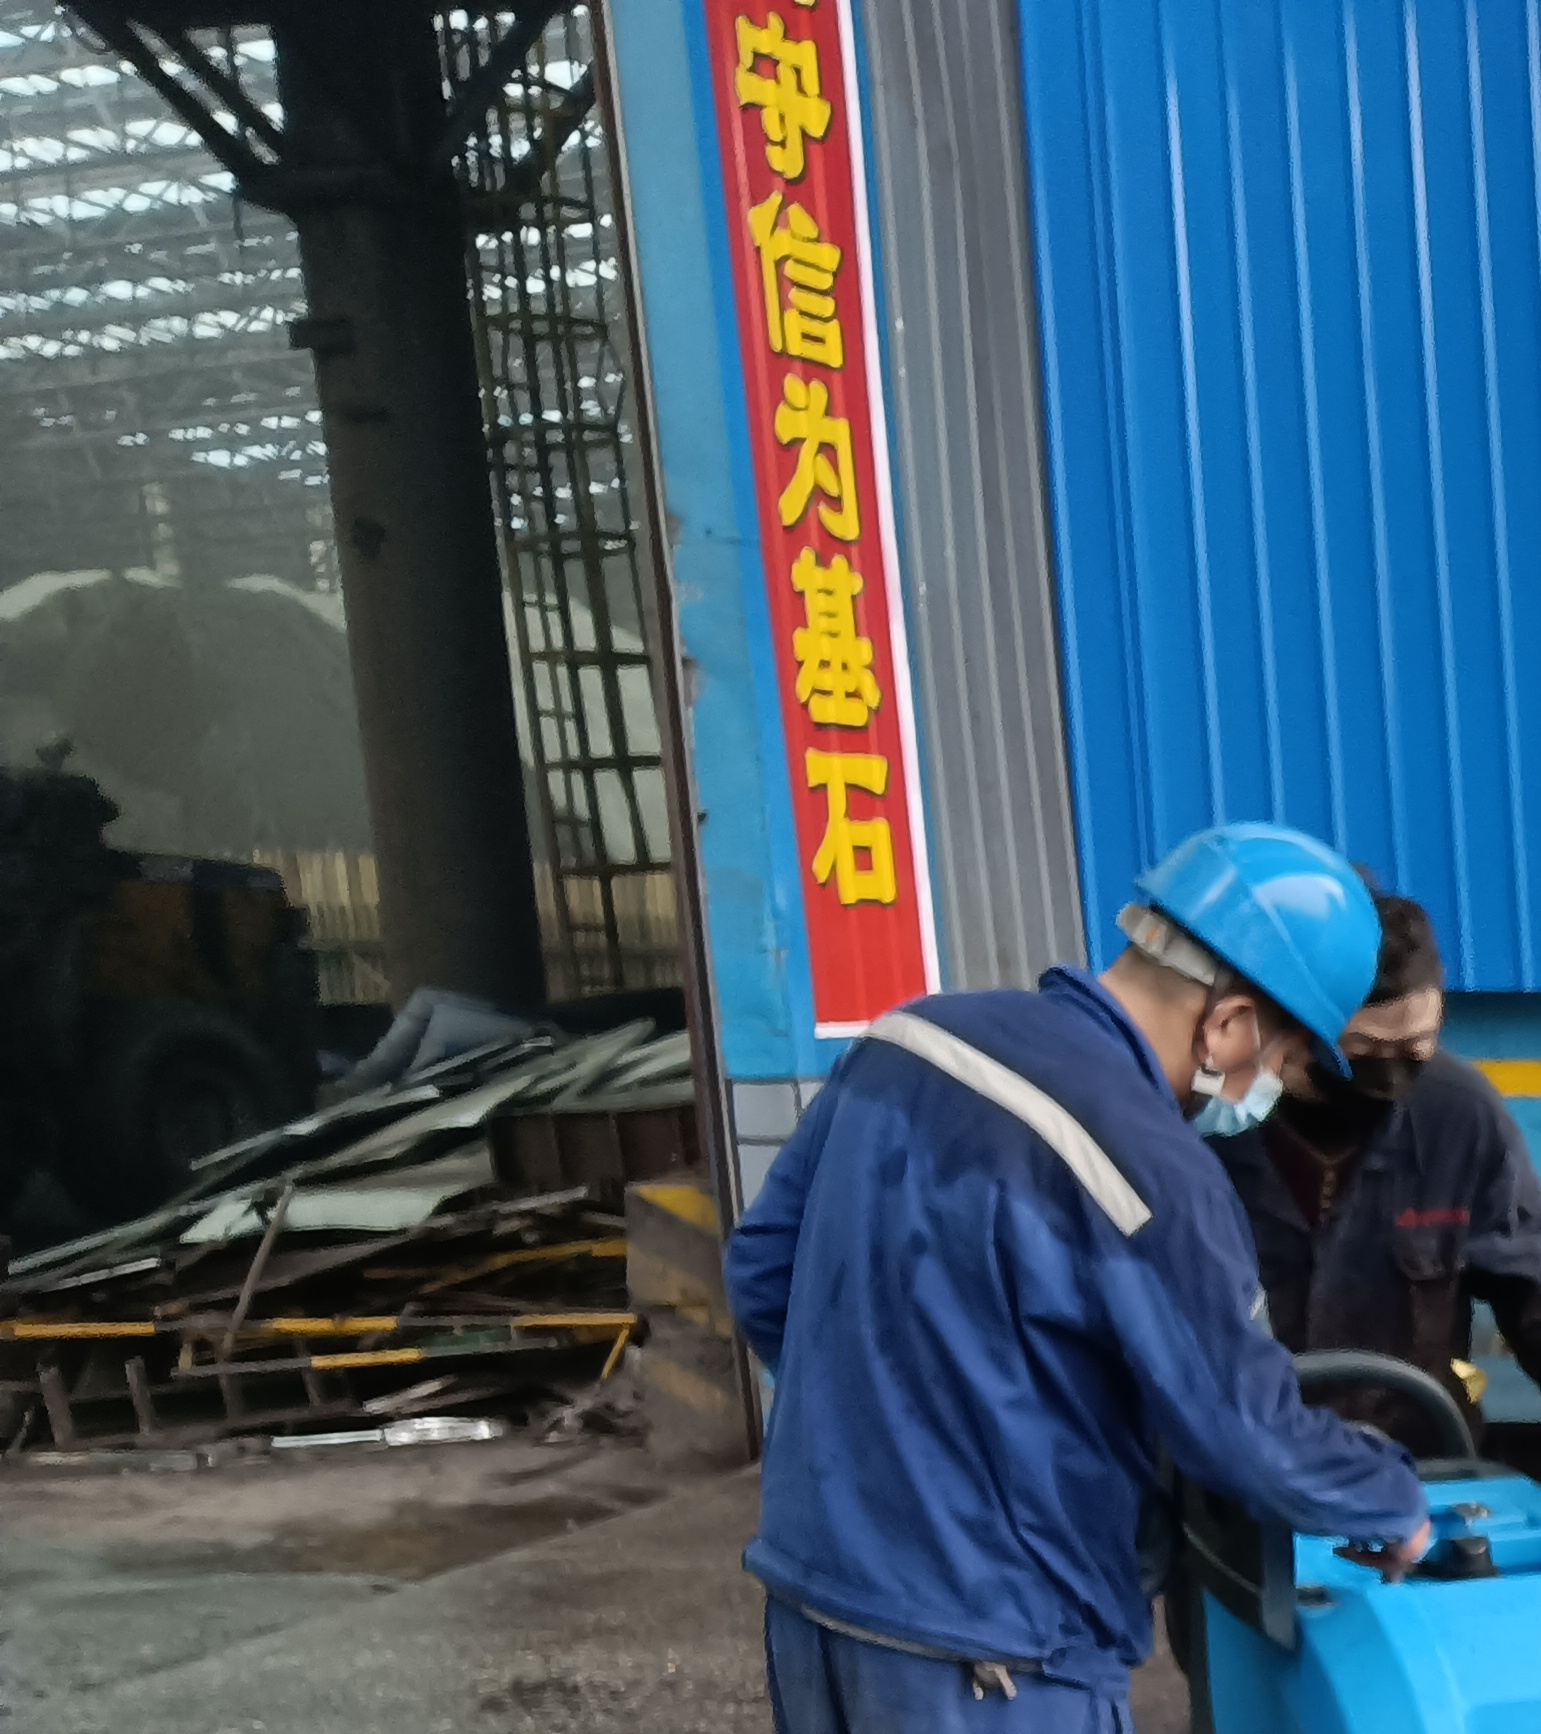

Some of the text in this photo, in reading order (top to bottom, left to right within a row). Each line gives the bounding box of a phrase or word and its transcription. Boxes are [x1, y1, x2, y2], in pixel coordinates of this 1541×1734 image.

[734, 0, 898, 907] 守信为基石
